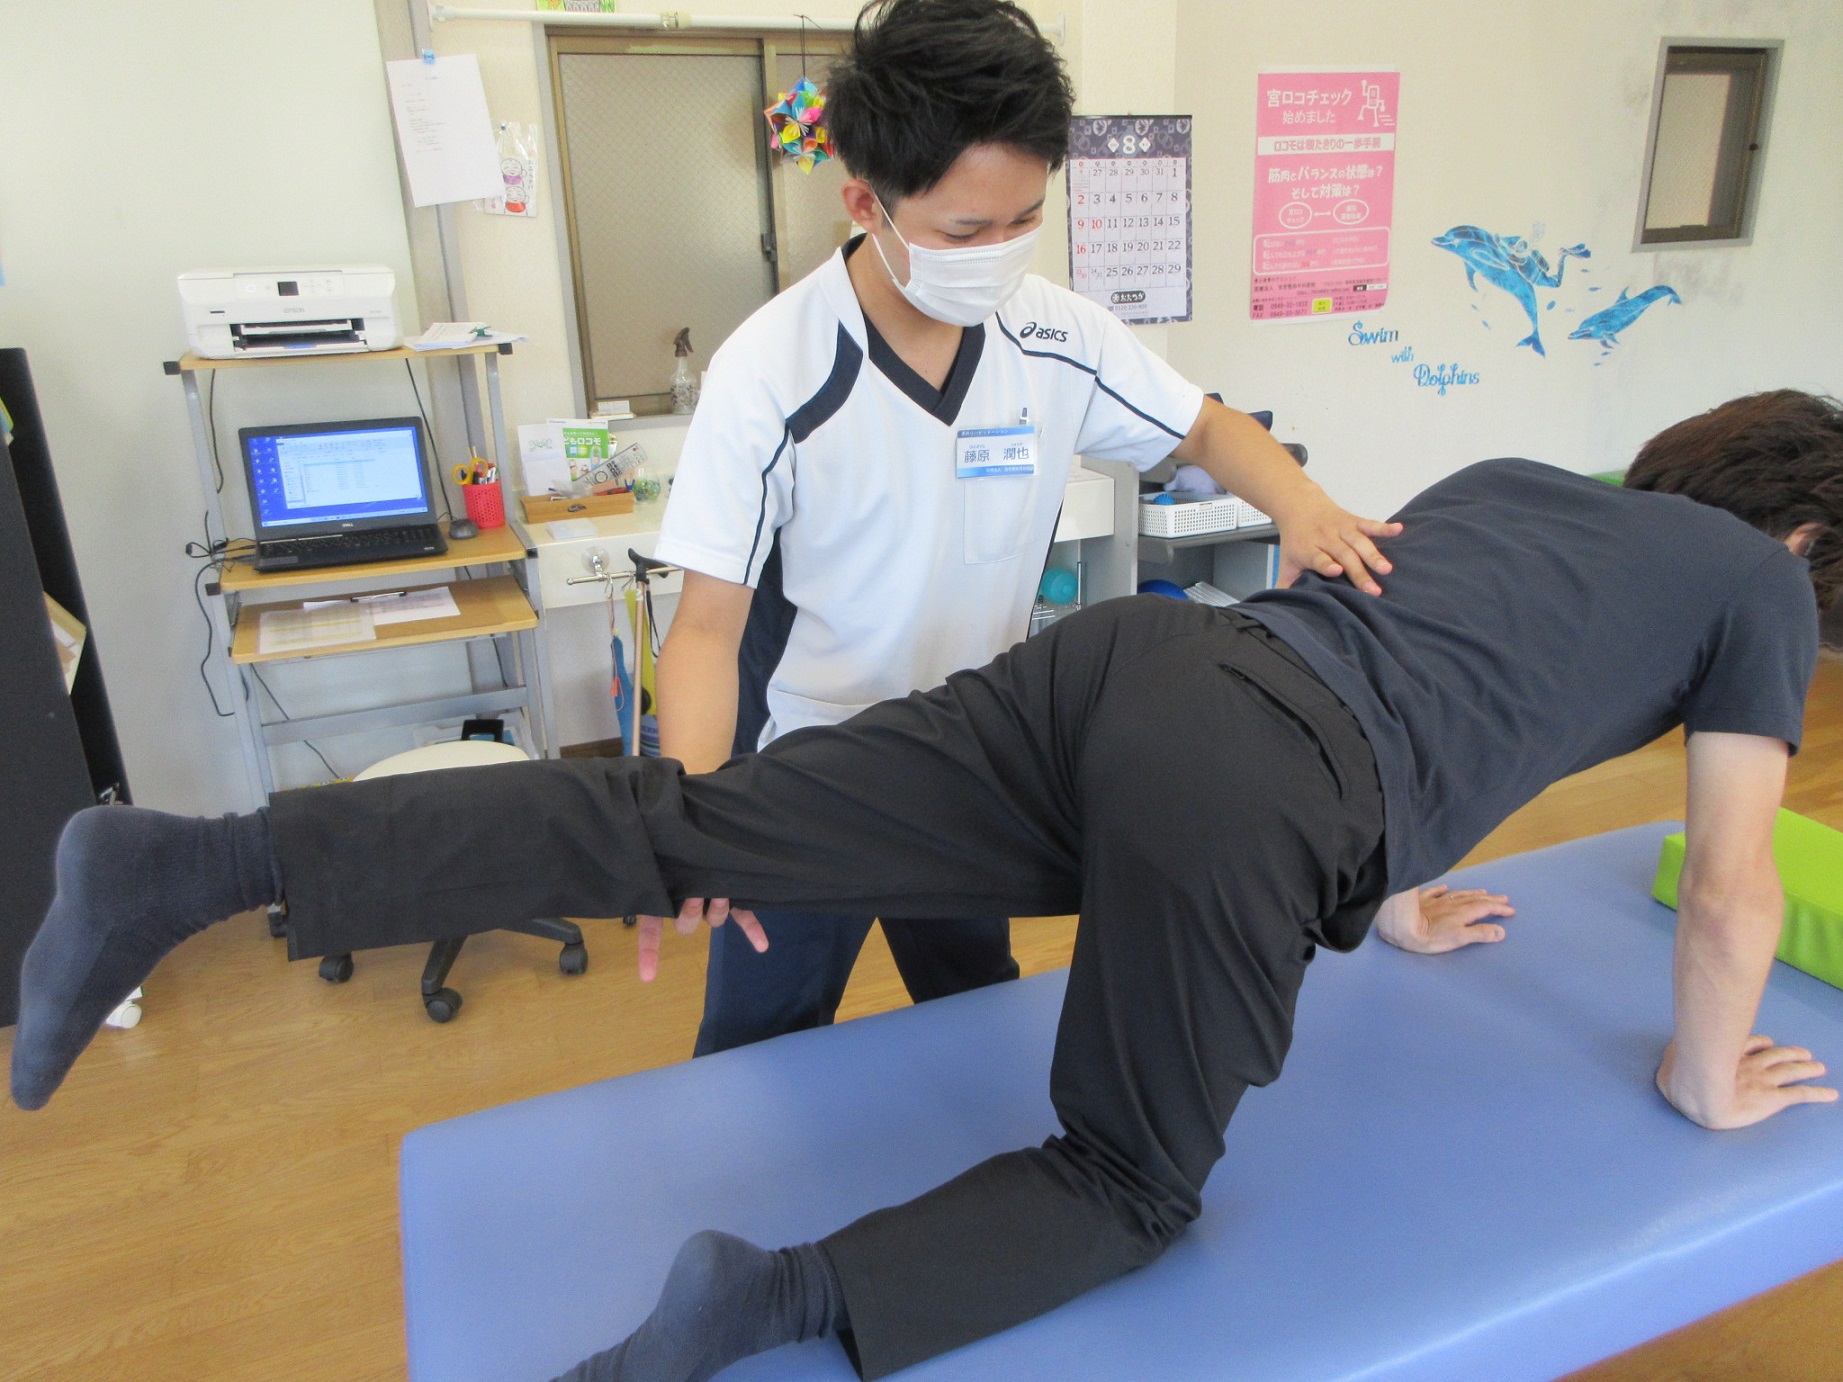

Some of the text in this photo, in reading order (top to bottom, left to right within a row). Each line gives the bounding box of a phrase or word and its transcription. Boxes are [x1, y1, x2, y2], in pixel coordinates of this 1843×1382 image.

[1282, 109, 1336, 125] 始めました
[1122, 135, 1136, 154] 8
[1172, 167, 1177, 177] 1
[1077, 192, 1178, 204] 2 3 4 5 6 7 8
[1077, 216, 1180, 229] 9 10 11 12 13 14 15
[1076, 240, 1181, 254] 16 17 18 19 20 21 22
[1106, 267, 1118, 277] 25
[1121, 266, 1134, 276] 26
[1137, 265, 1149, 276] 27
[1152, 264, 1164, 275] 28
[1168, 264, 1181, 274] 29
[1036, 326, 1068, 342] asics
[1348, 320, 1399, 346] Swim
[1391, 346, 1414, 363] with
[1413, 362, 1480, 396] Dolphins
